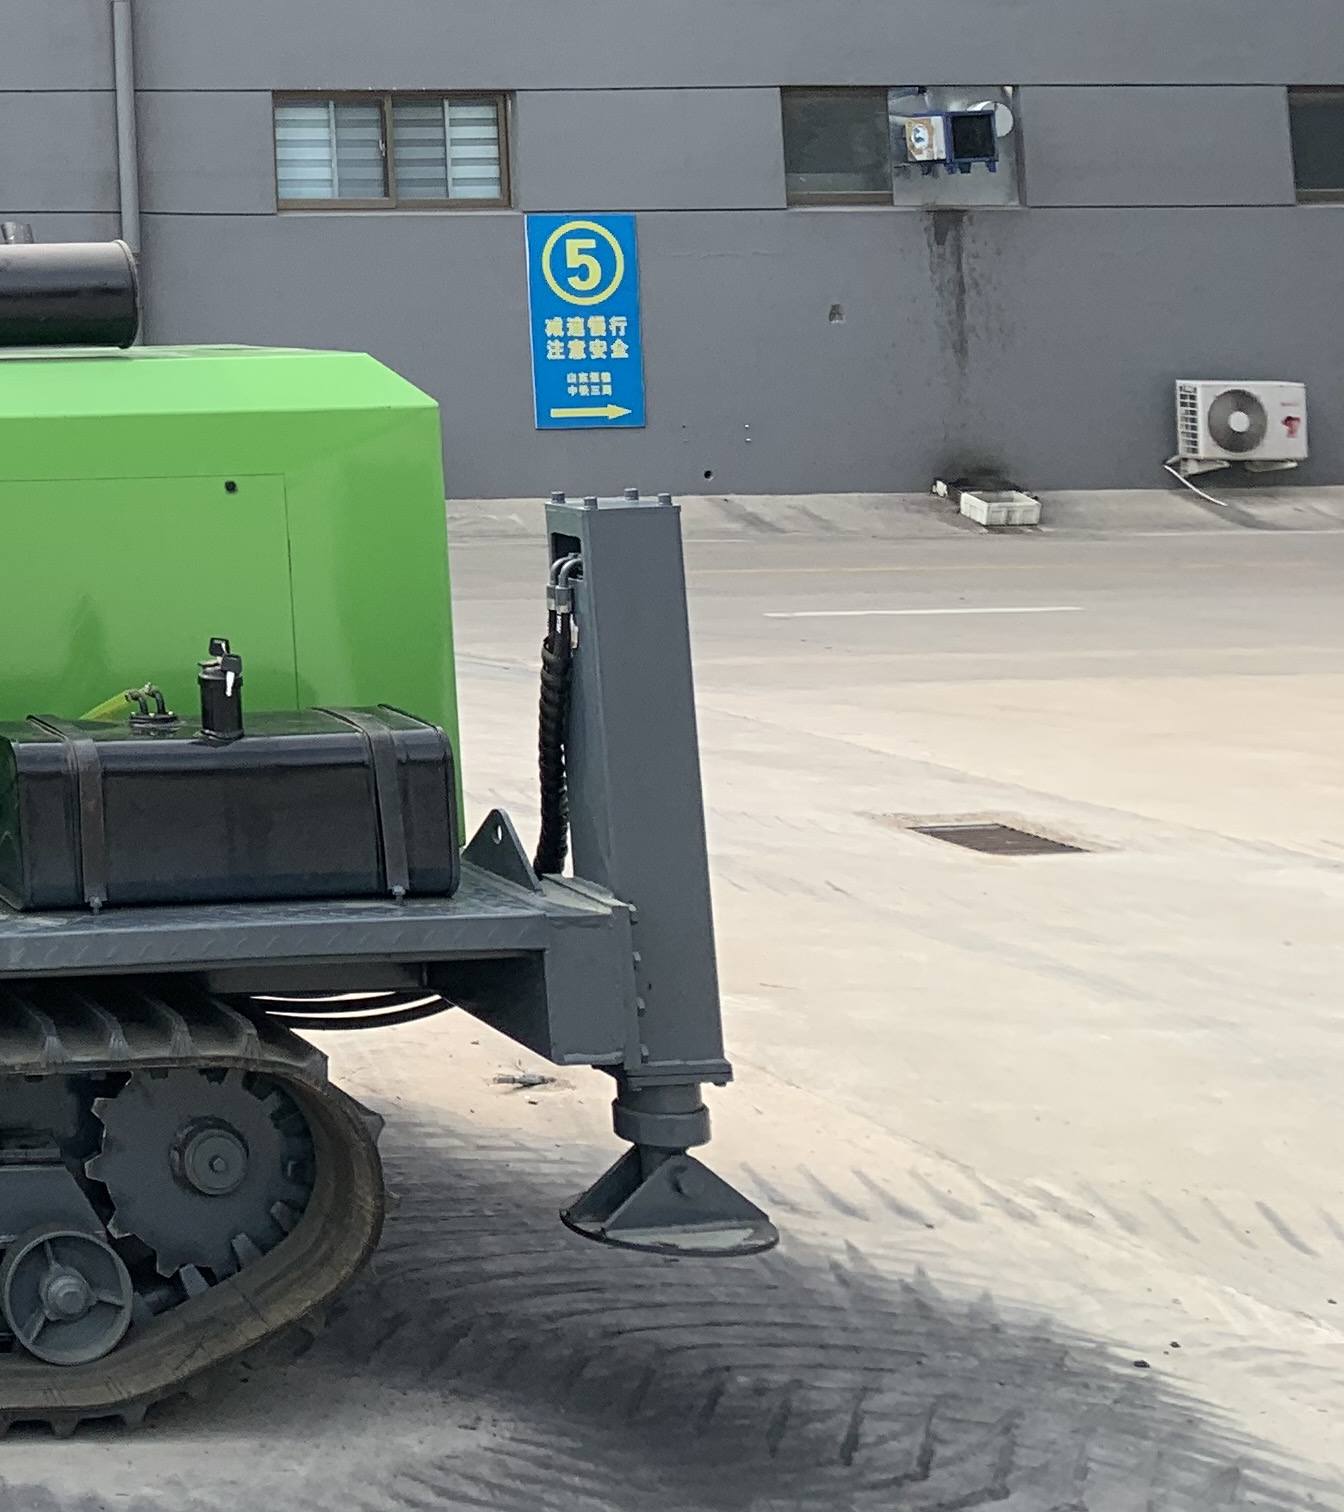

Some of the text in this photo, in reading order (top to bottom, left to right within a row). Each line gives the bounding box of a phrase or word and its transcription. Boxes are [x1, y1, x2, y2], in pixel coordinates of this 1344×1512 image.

[565, 238, 602, 291] 5
[544, 315, 628, 337] 减速慢行
[546, 338, 630, 360] 注意安全
